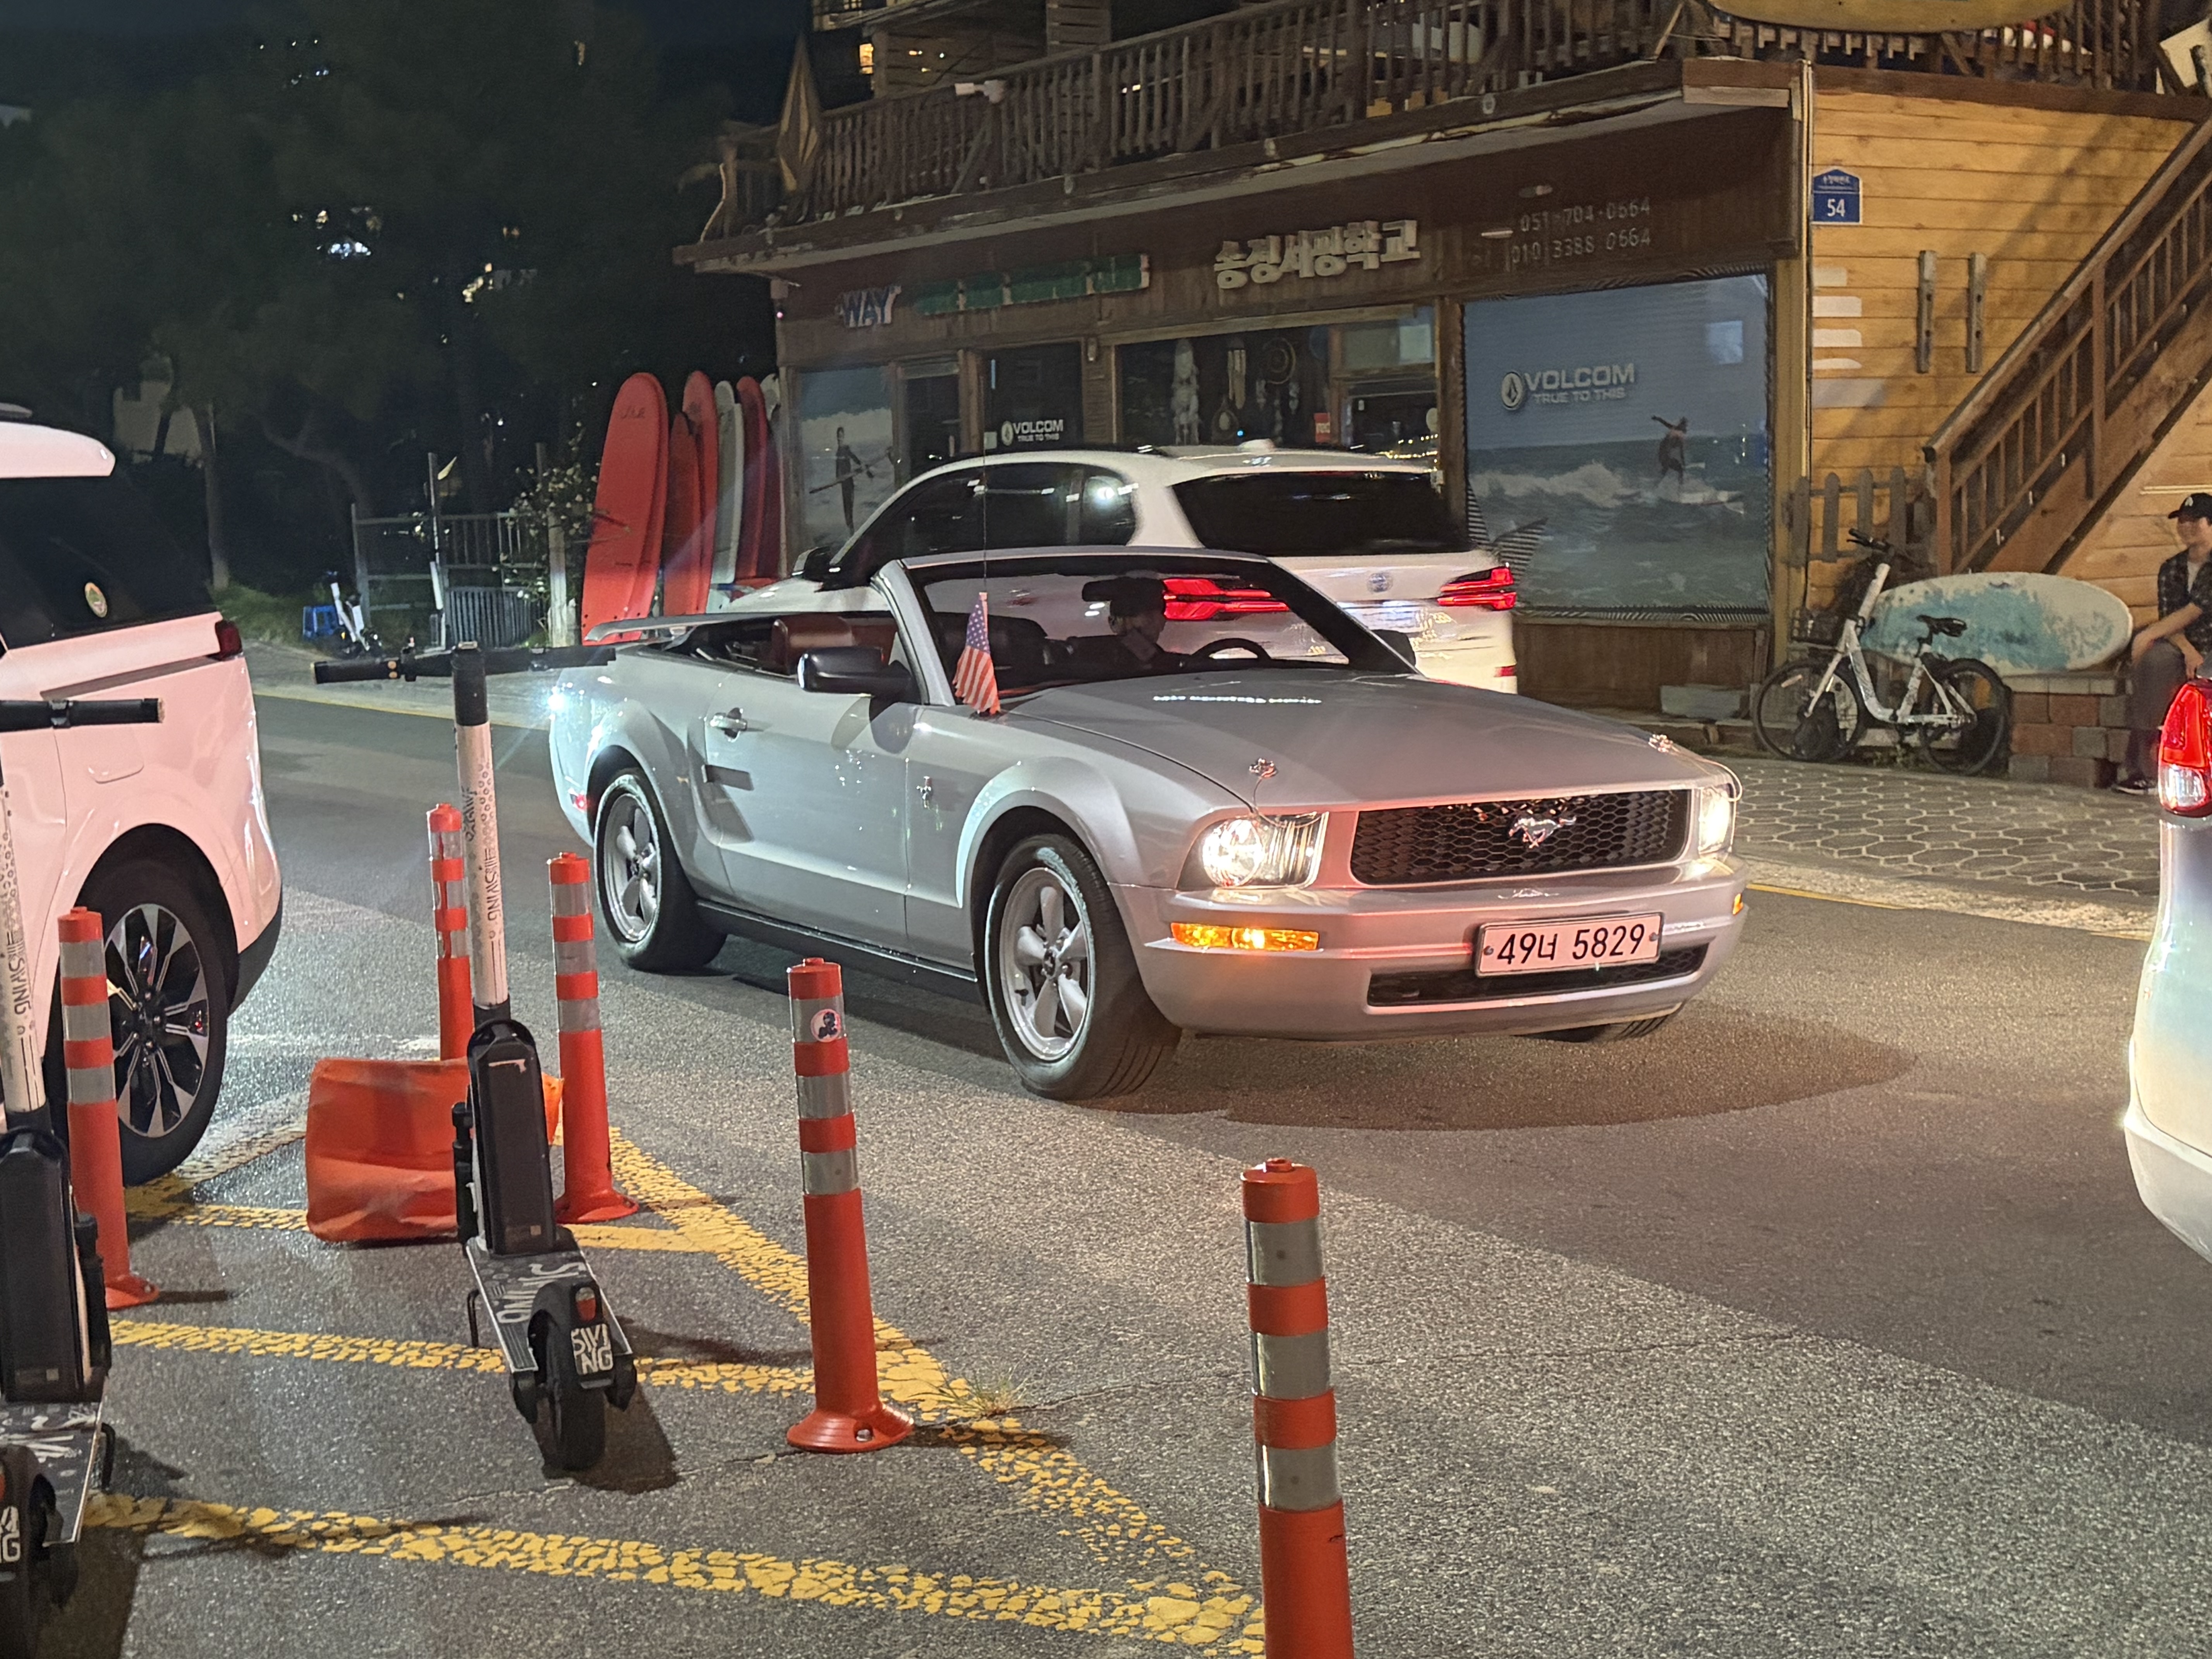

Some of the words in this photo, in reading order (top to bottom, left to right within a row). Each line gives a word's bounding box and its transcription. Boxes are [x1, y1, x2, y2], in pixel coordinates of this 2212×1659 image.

[1827, 198, 1846, 217] 54
[1214, 219, 1421, 289] 송정서핑학교
[1523, 363, 1635, 391] VOLCOM
[1533, 391, 1569, 404] TRUE
[1571, 390, 1590, 402] TO
[1594, 387, 1626, 400] THIS
[1012, 419, 1064, 434] VOLCOM
[485, 871, 501, 921] SWING
[1497, 932, 1558, 965] 49너
[1572, 924, 1645, 960] 5829
[8, 957, 32, 1015] SWING
